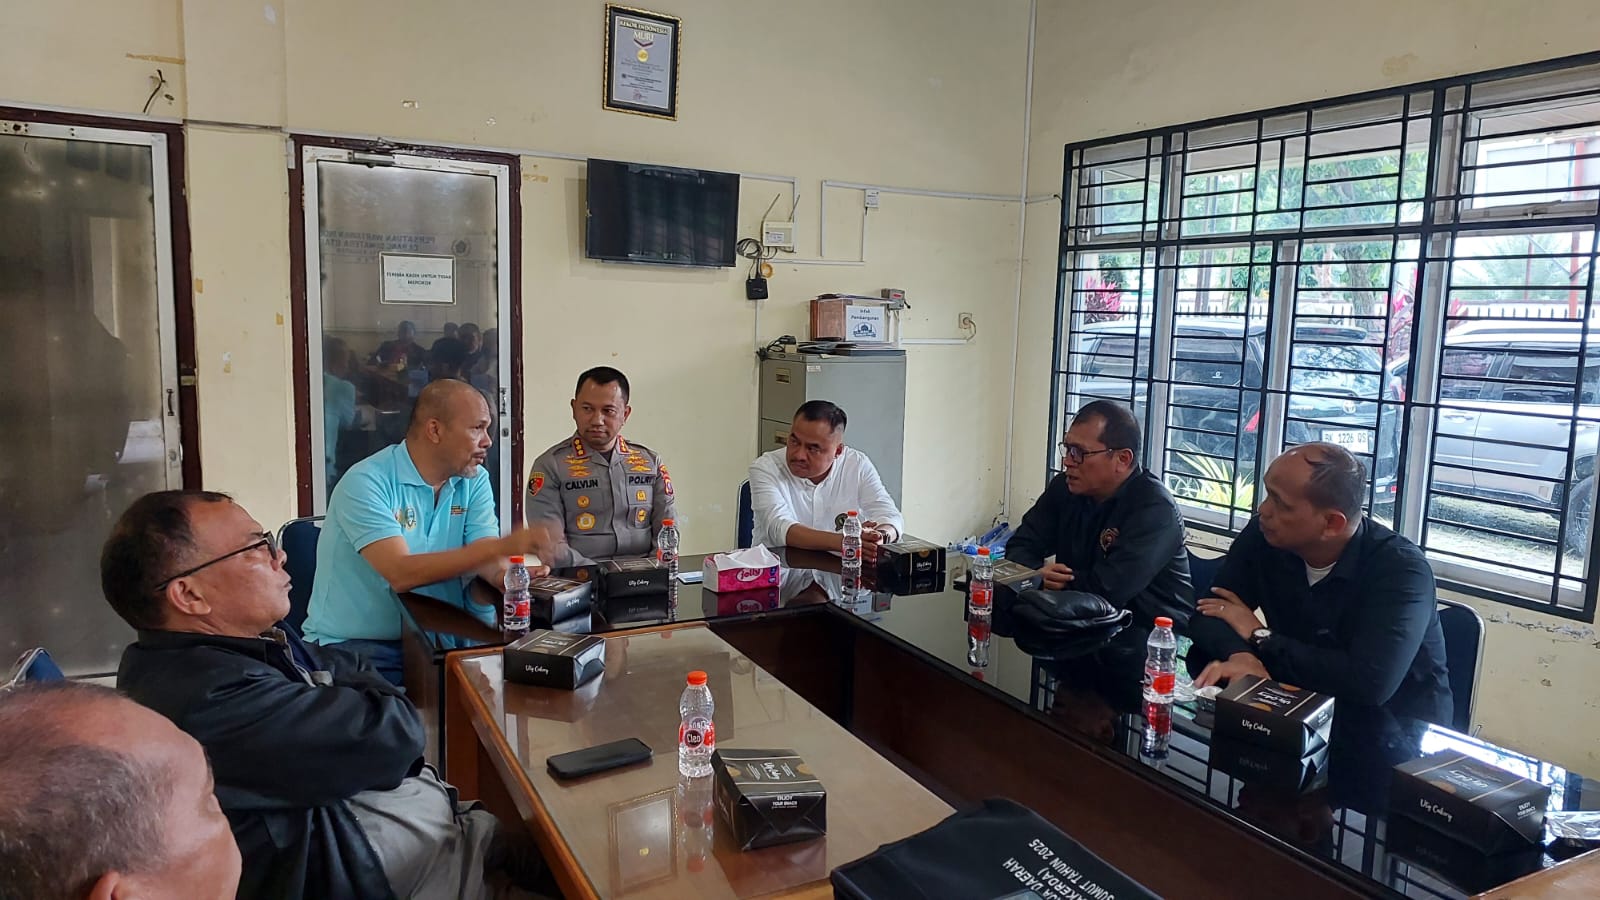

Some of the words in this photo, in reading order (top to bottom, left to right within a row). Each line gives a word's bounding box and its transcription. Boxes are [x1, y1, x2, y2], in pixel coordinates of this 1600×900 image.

[1338, 433, 1354, 443] 1226
[565, 479, 599, 491] CALVIJN
[628, 475, 653, 485] POLRI
[687, 733, 700, 743] Cleo
[1027, 838, 1055, 860] 2025
[1002, 857, 1044, 891] DAERAH
[1049, 857, 1083, 884] TAHUN
[1078, 880, 1115, 900] SUMUT
